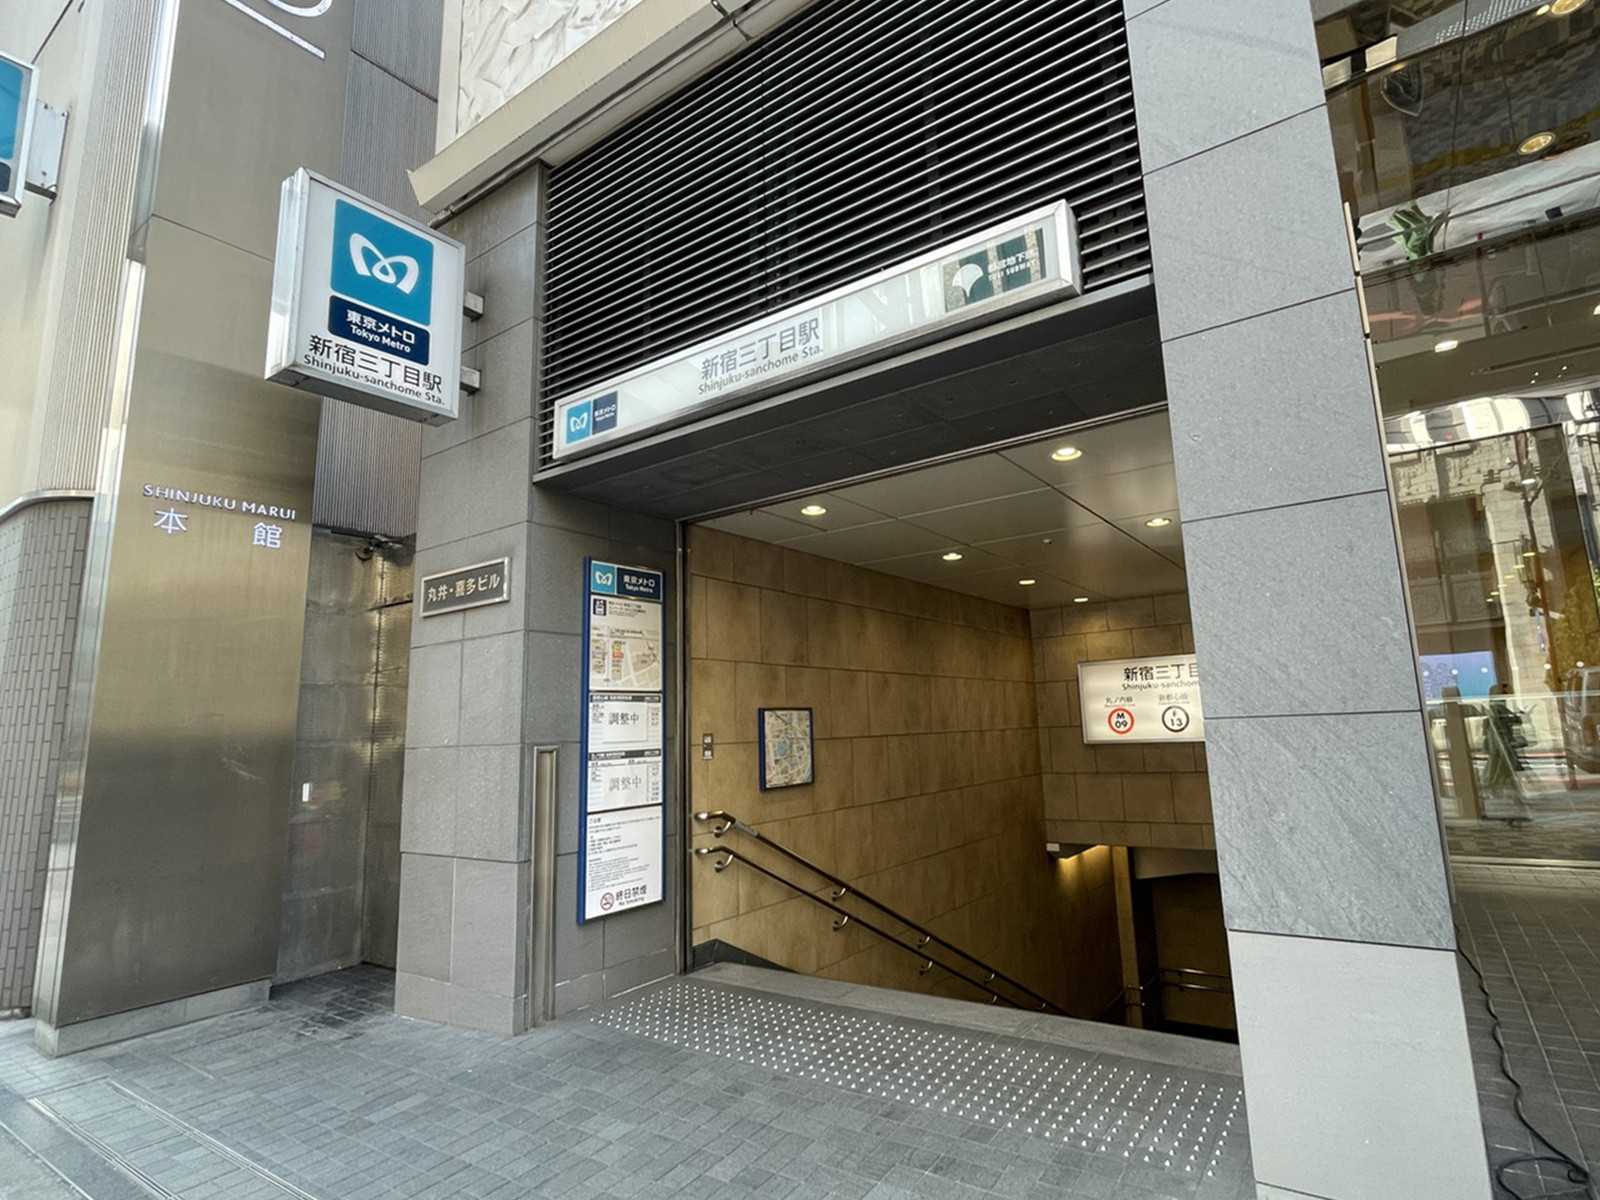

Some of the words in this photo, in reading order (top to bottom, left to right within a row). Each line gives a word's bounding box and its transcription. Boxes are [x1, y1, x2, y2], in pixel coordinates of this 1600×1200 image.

[346, 309, 415, 344] 東京メトロ
[350, 325, 380, 342] Tokyo
[382, 336, 411, 353] Metro
[309, 334, 442, 393] 新宿三丁目駅
[701, 317, 819, 380] 新宿三丁目駅
[304, 354, 422, 398] Shinjuku-sanchome
[425, 391, 445, 405] Sta.
[698, 352, 799, 395] Shinjuku-sanchome
[802, 344, 824, 359] Sta.
[143, 484, 236, 510] SHINJUKU
[242, 501, 296, 520] MARUI
[1115, 720, 1128, 729] 09
[1170, 718, 1183, 727] 13
